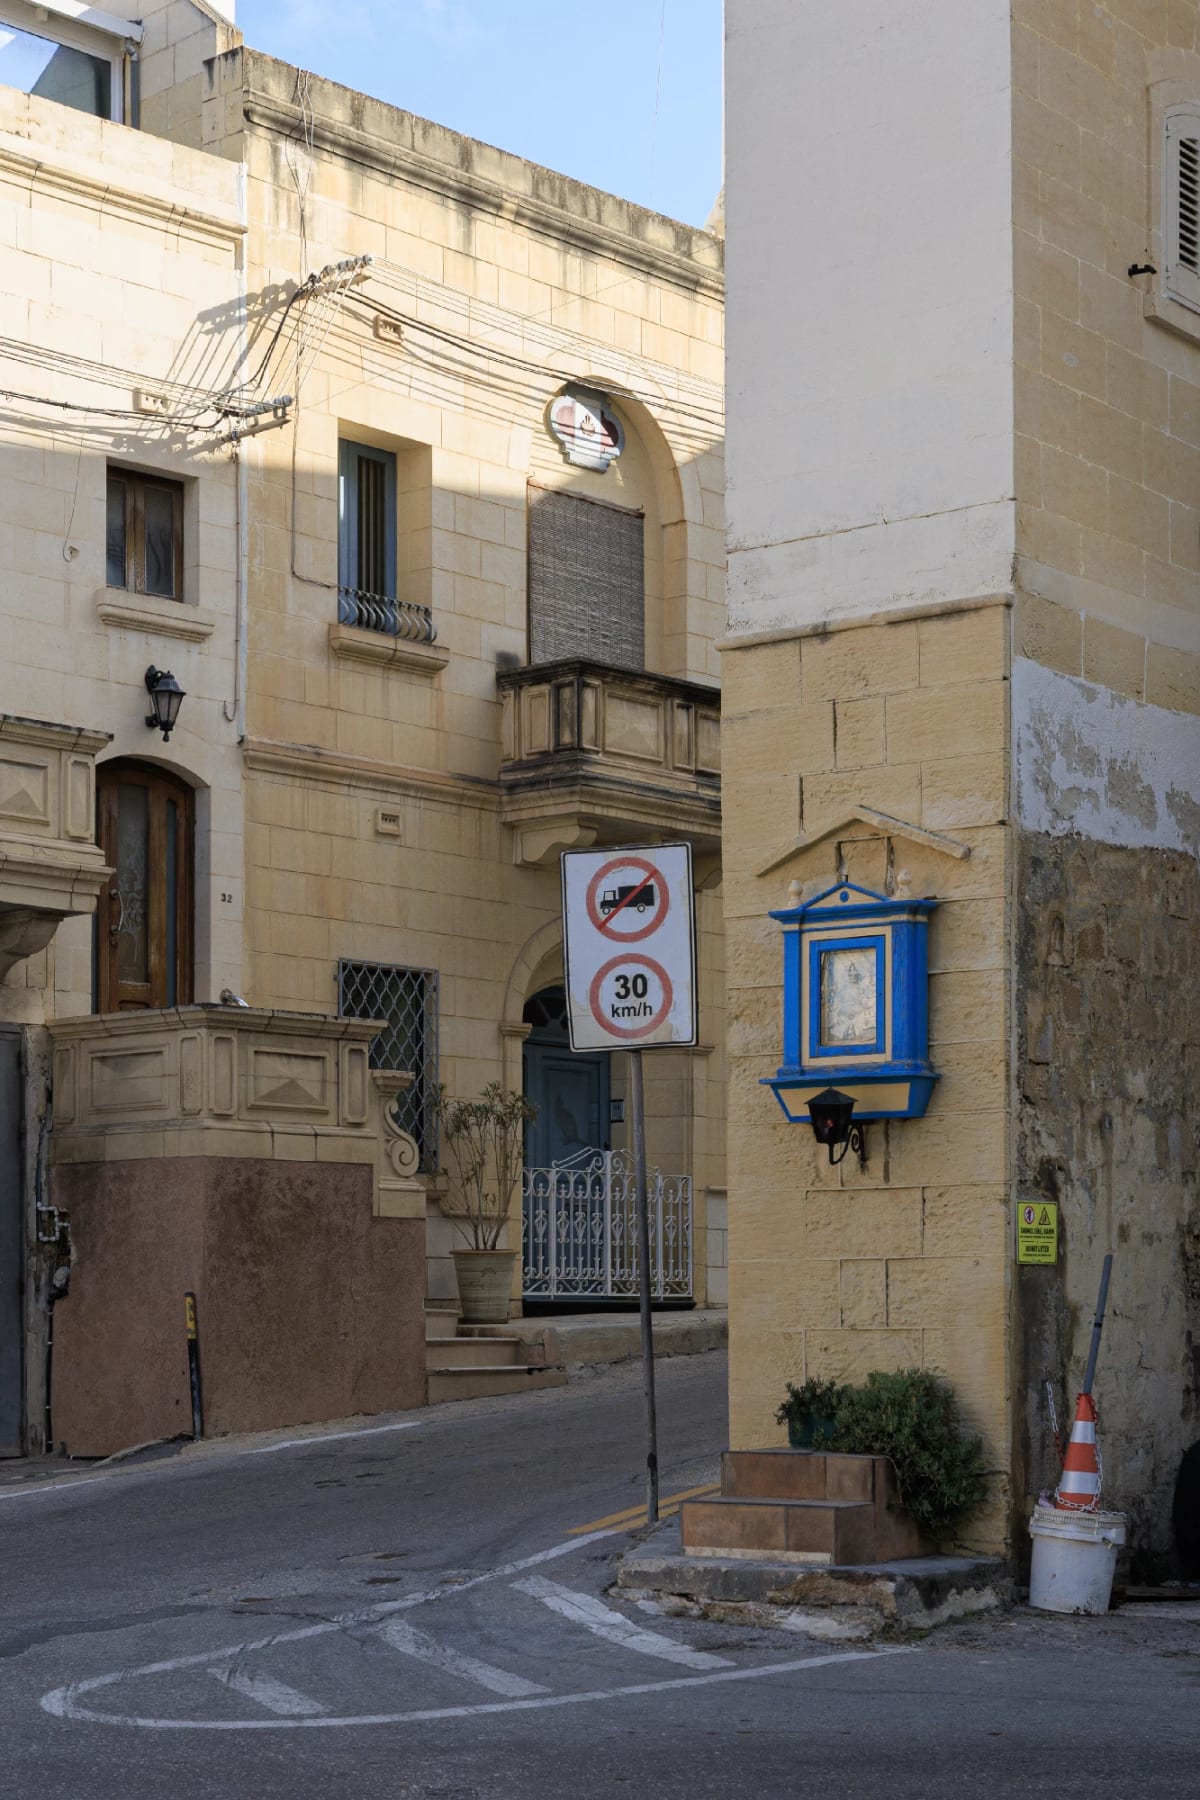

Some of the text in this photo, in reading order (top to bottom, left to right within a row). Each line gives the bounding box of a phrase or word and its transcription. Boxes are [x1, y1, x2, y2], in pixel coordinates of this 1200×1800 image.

[220, 892, 233, 904] 32
[614, 973, 648, 1000] 30
[611, 1001, 653, 1018] km/h
